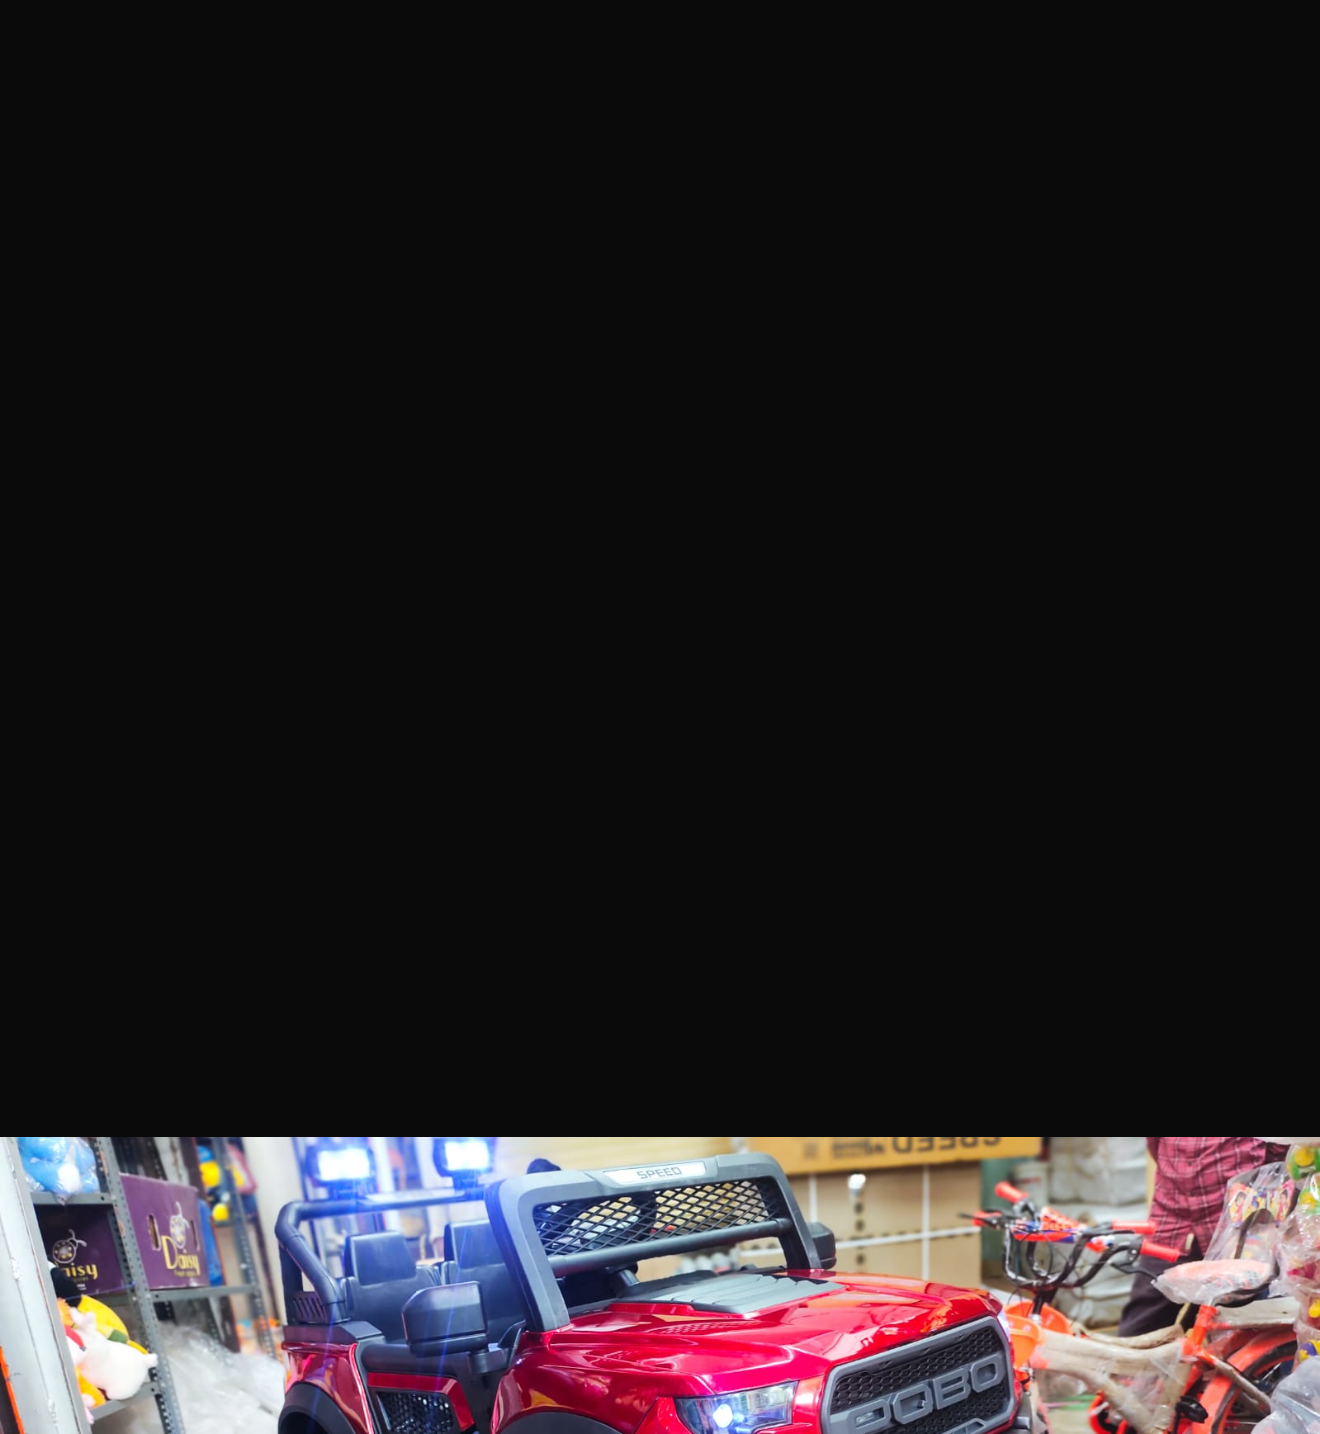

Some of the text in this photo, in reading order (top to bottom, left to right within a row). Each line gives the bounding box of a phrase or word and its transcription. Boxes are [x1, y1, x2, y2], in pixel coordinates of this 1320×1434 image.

[637, 1167, 683, 1180] SPEED
[161, 1234, 201, 1276] Daisy
[59, 1262, 98, 1280] aisy
